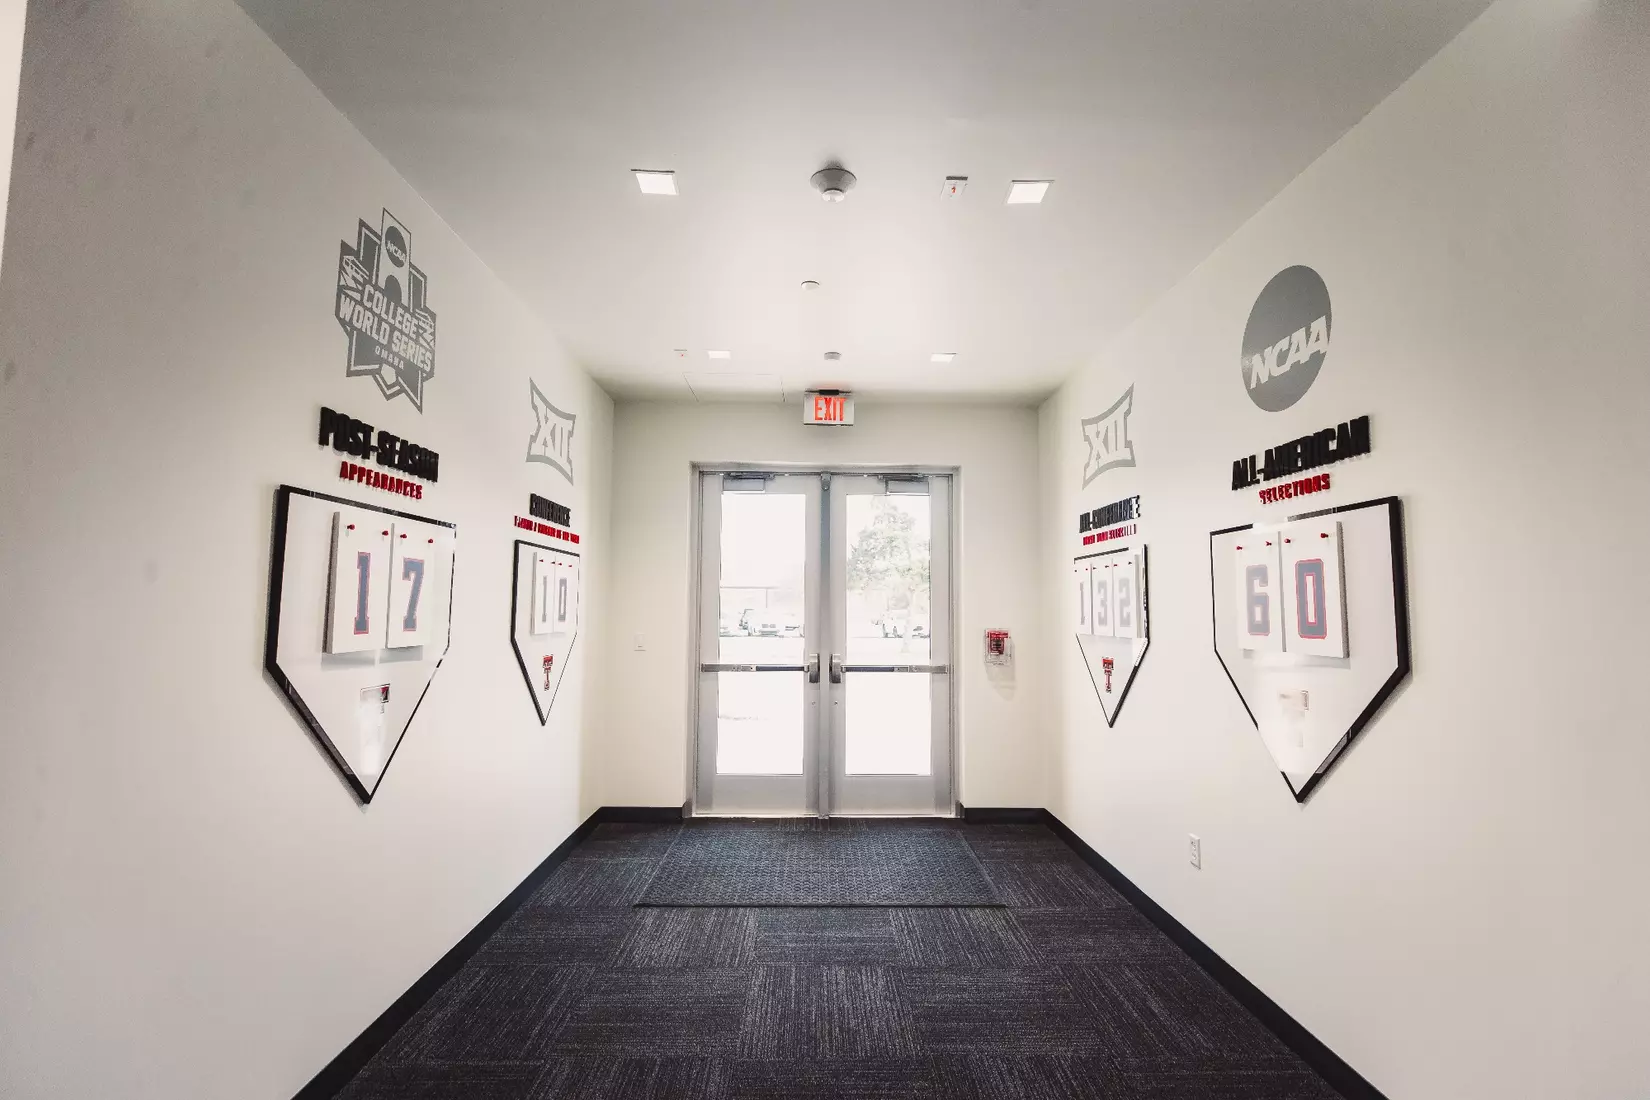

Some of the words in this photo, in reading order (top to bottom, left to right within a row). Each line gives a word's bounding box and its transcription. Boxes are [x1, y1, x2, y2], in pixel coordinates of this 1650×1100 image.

[387, 239, 407, 263] NCAA
[340, 294, 390, 345] WORLD
[391, 332, 433, 373] SERIES
[363, 284, 418, 339] COLLEGE
[374, 345, 404, 370] OMAHA
[1250, 315, 1328, 389] NCAA
[814, 396, 847, 422] EXIT
[318, 406, 440, 483] POST-SEASON
[1231, 415, 1371, 491] ALL-AMERICAN
[339, 460, 423, 500] APPEARANCES
[1259, 473, 1331, 504] SELECTIONS
[353, 551, 425, 635] 17
[541, 575, 568, 623] 10
[1079, 576, 1131, 628] 132
[1245, 558, 1328, 640] 60
